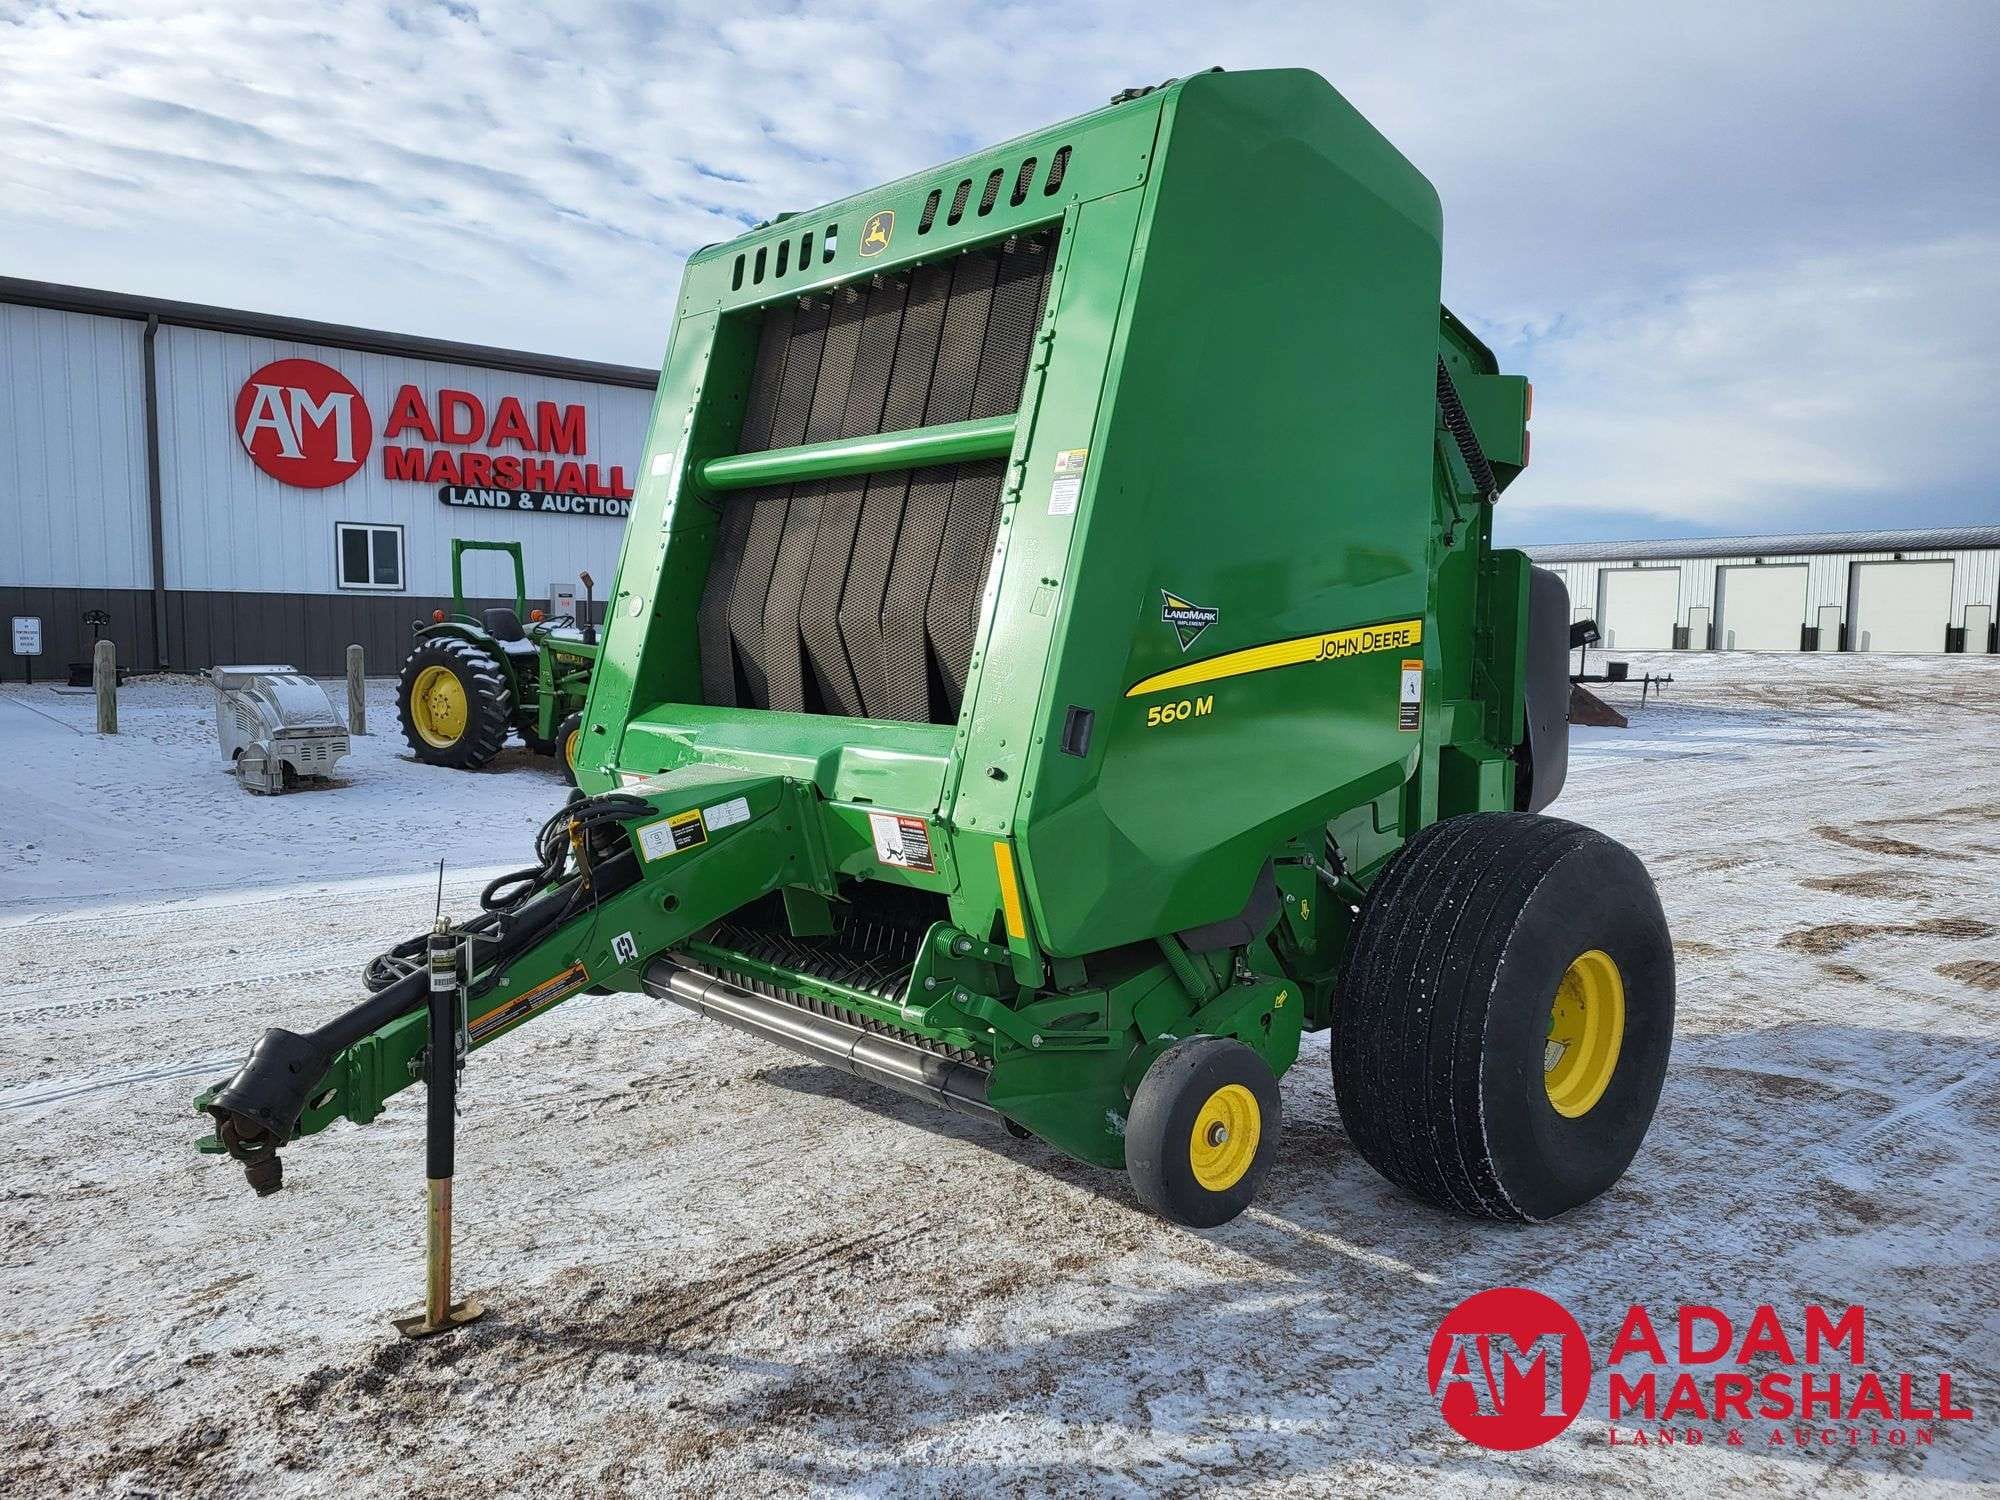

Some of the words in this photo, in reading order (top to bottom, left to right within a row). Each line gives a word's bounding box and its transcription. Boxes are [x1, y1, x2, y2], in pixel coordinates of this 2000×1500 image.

[242, 383, 357, 463] AM
[383, 384, 587, 456] ADAM
[383, 445, 634, 497] MARSHALL
[449, 488, 511, 508] LAND
[518, 492, 534, 510] &
[541, 495, 634, 516] AUCTION
[1164, 608, 1216, 621] LANDMARK
[1316, 637, 1359, 659] JOHN
[1362, 629, 1410, 651] DEERE
[1147, 700, 1192, 727] 560
[1195, 695, 1214, 717] M
